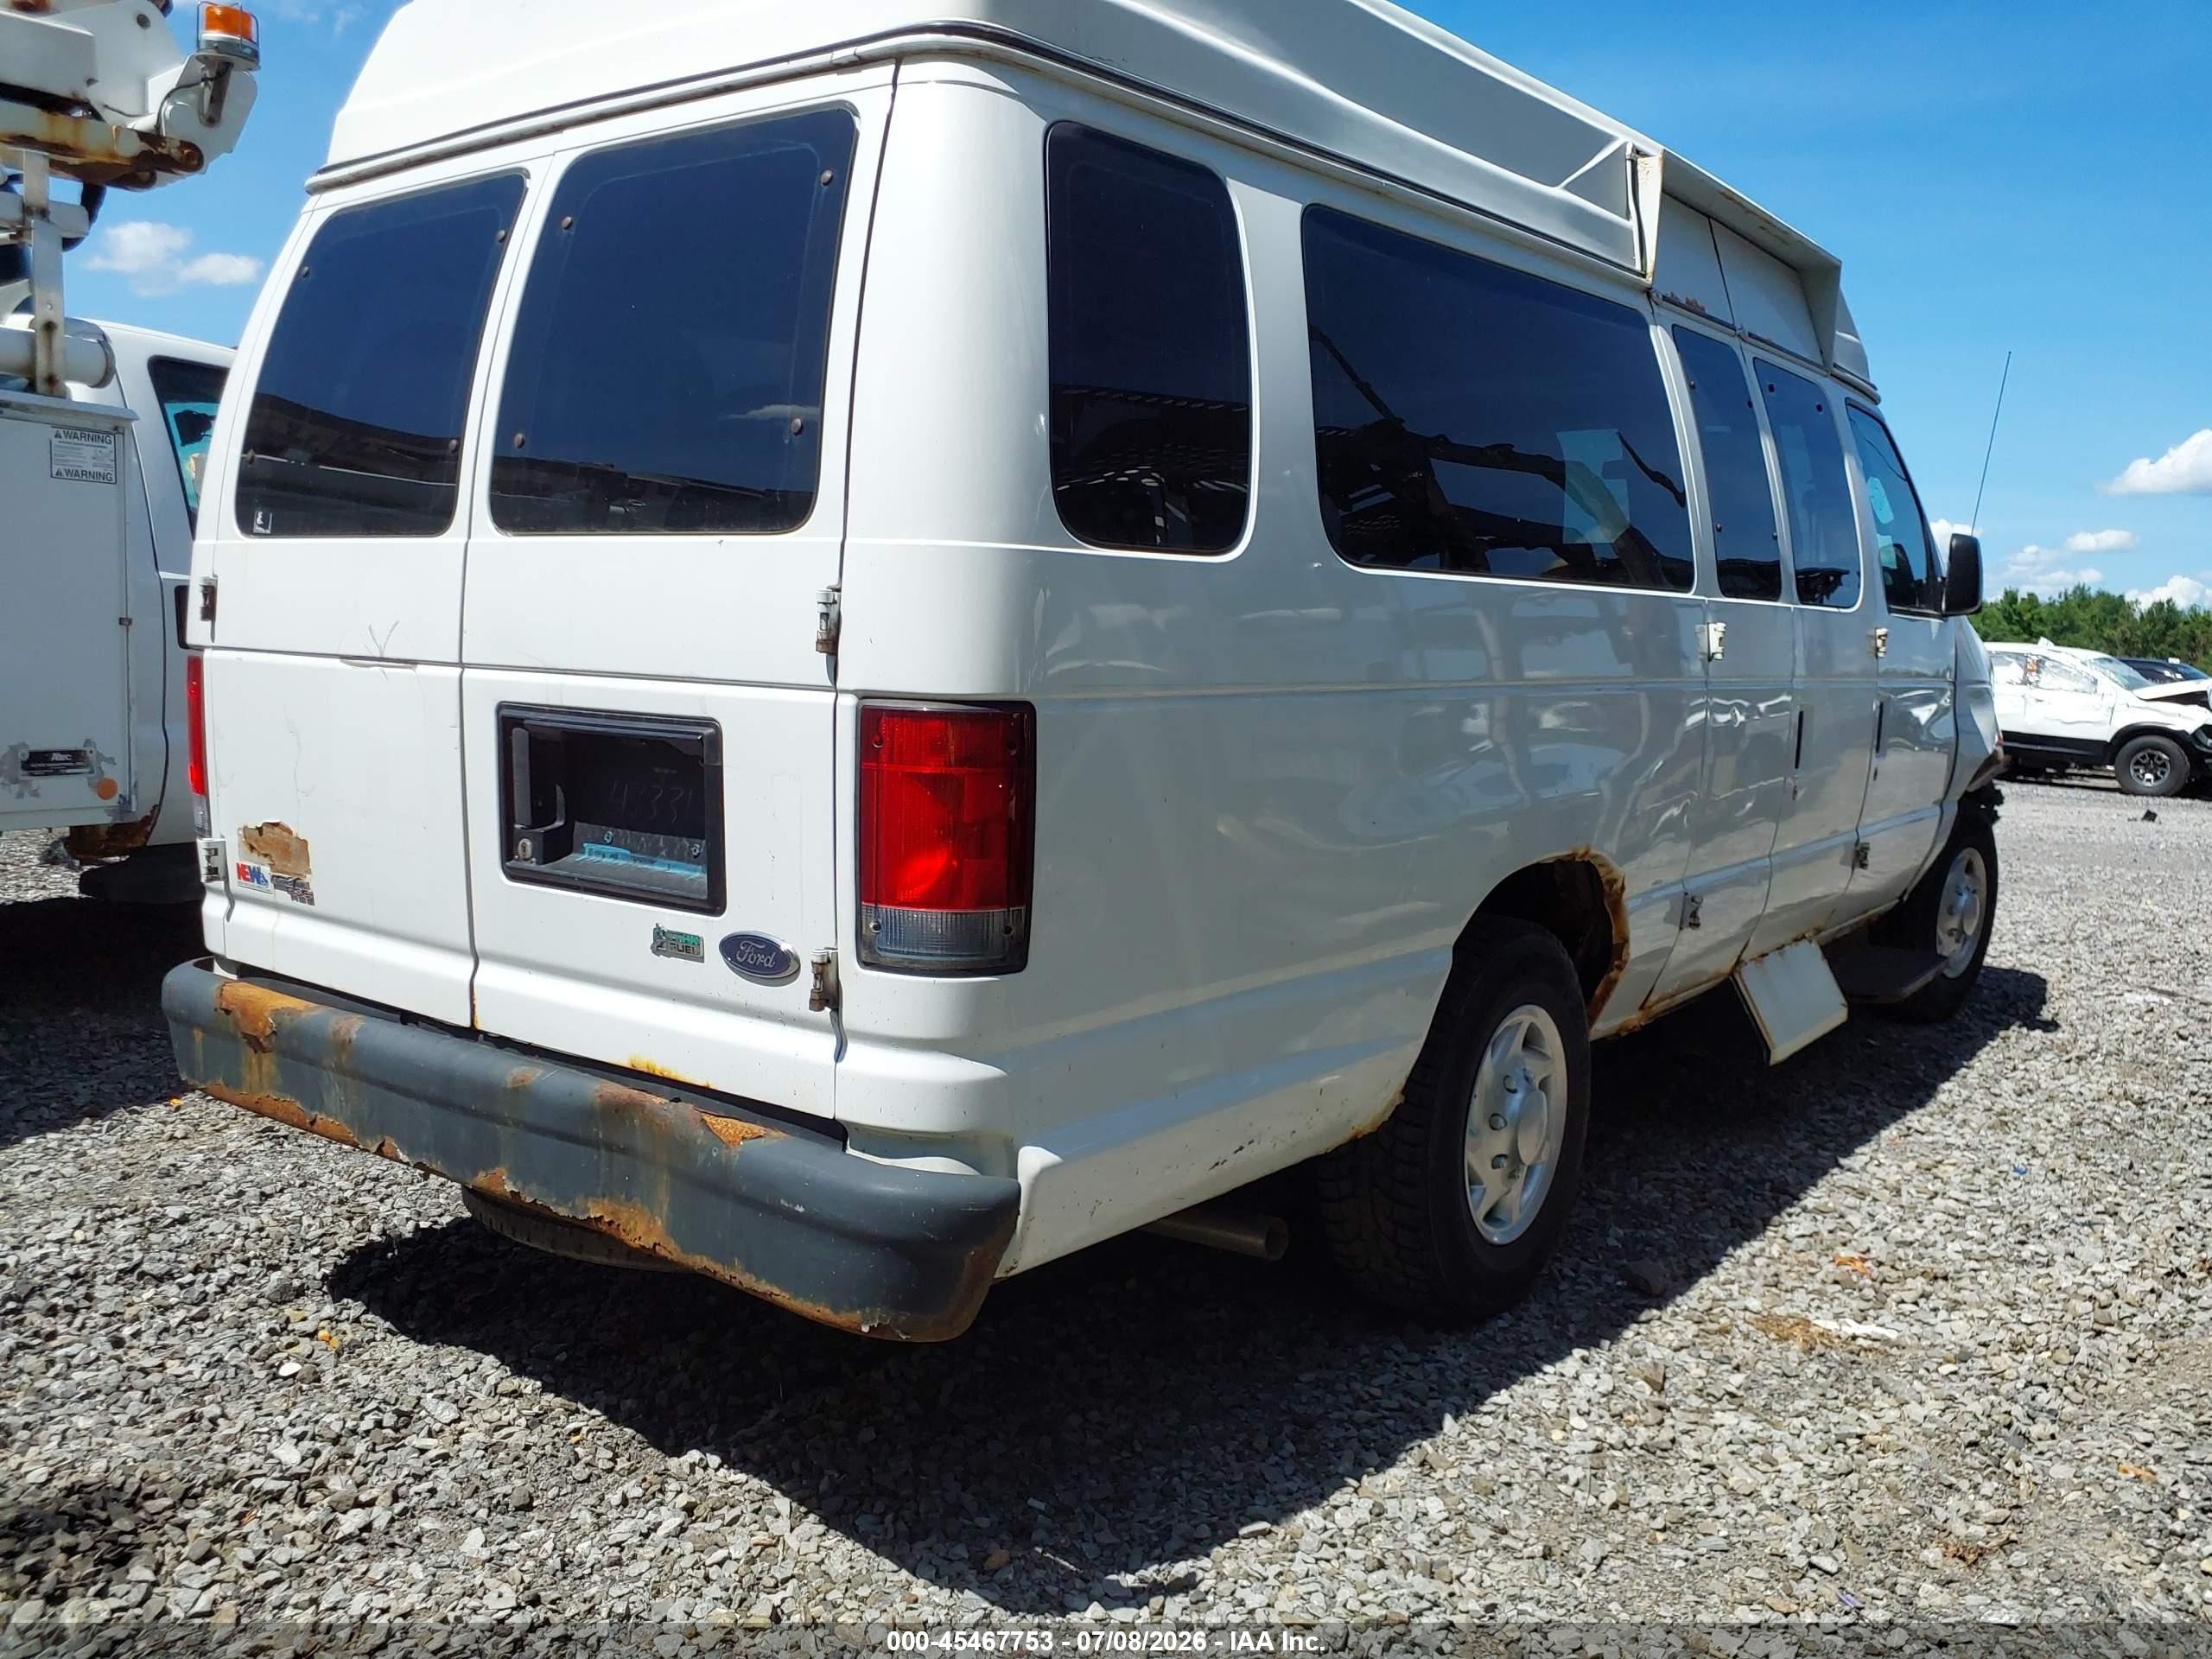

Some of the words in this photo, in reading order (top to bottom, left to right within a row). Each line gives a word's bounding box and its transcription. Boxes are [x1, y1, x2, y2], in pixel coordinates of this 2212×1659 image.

[63, 430, 111, 444] WARNING
[64, 468, 113, 481] WARNING
[670, 942, 700, 955] FUEL
[736, 940, 776, 969] Ford
